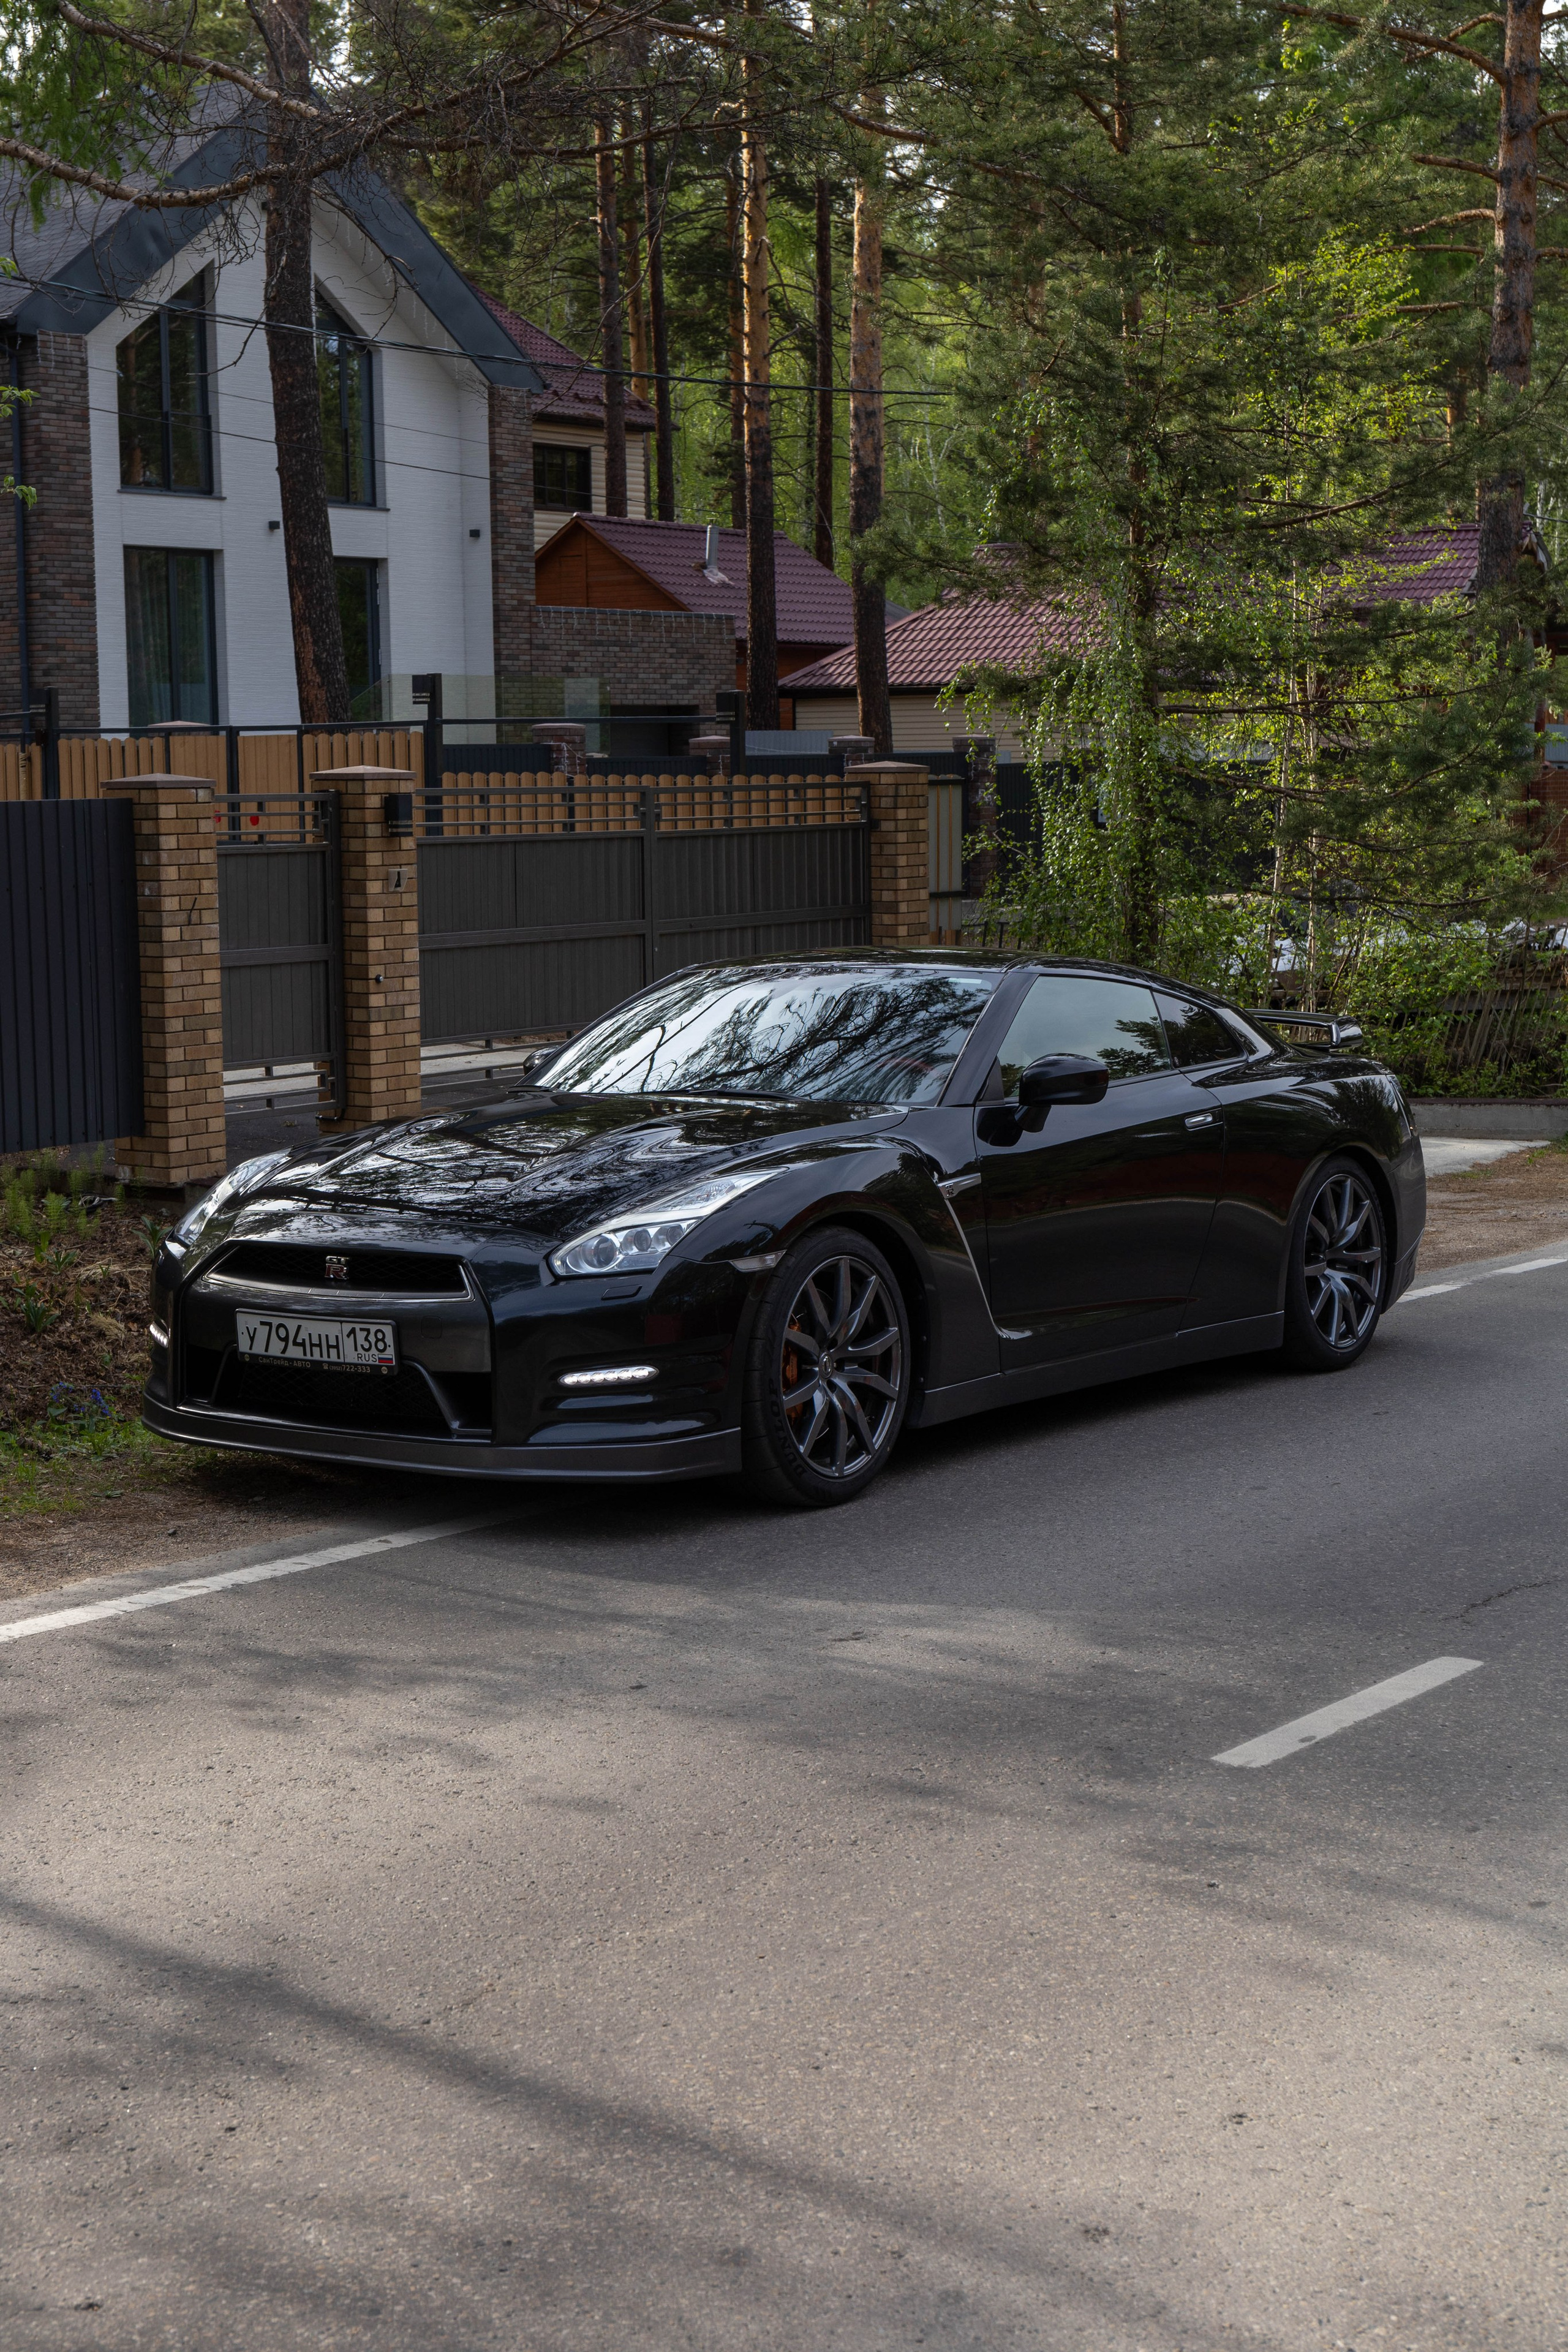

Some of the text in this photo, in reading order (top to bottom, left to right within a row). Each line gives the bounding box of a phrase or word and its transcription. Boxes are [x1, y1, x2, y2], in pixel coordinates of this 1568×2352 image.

[326, 1256, 350, 1264] GT
[324, 1264, 349, 1280] R
[346, 1327, 388, 1353] 138
[357, 1354, 377, 1362] RUS
[769, 1378, 808, 1477] DUNLOP
